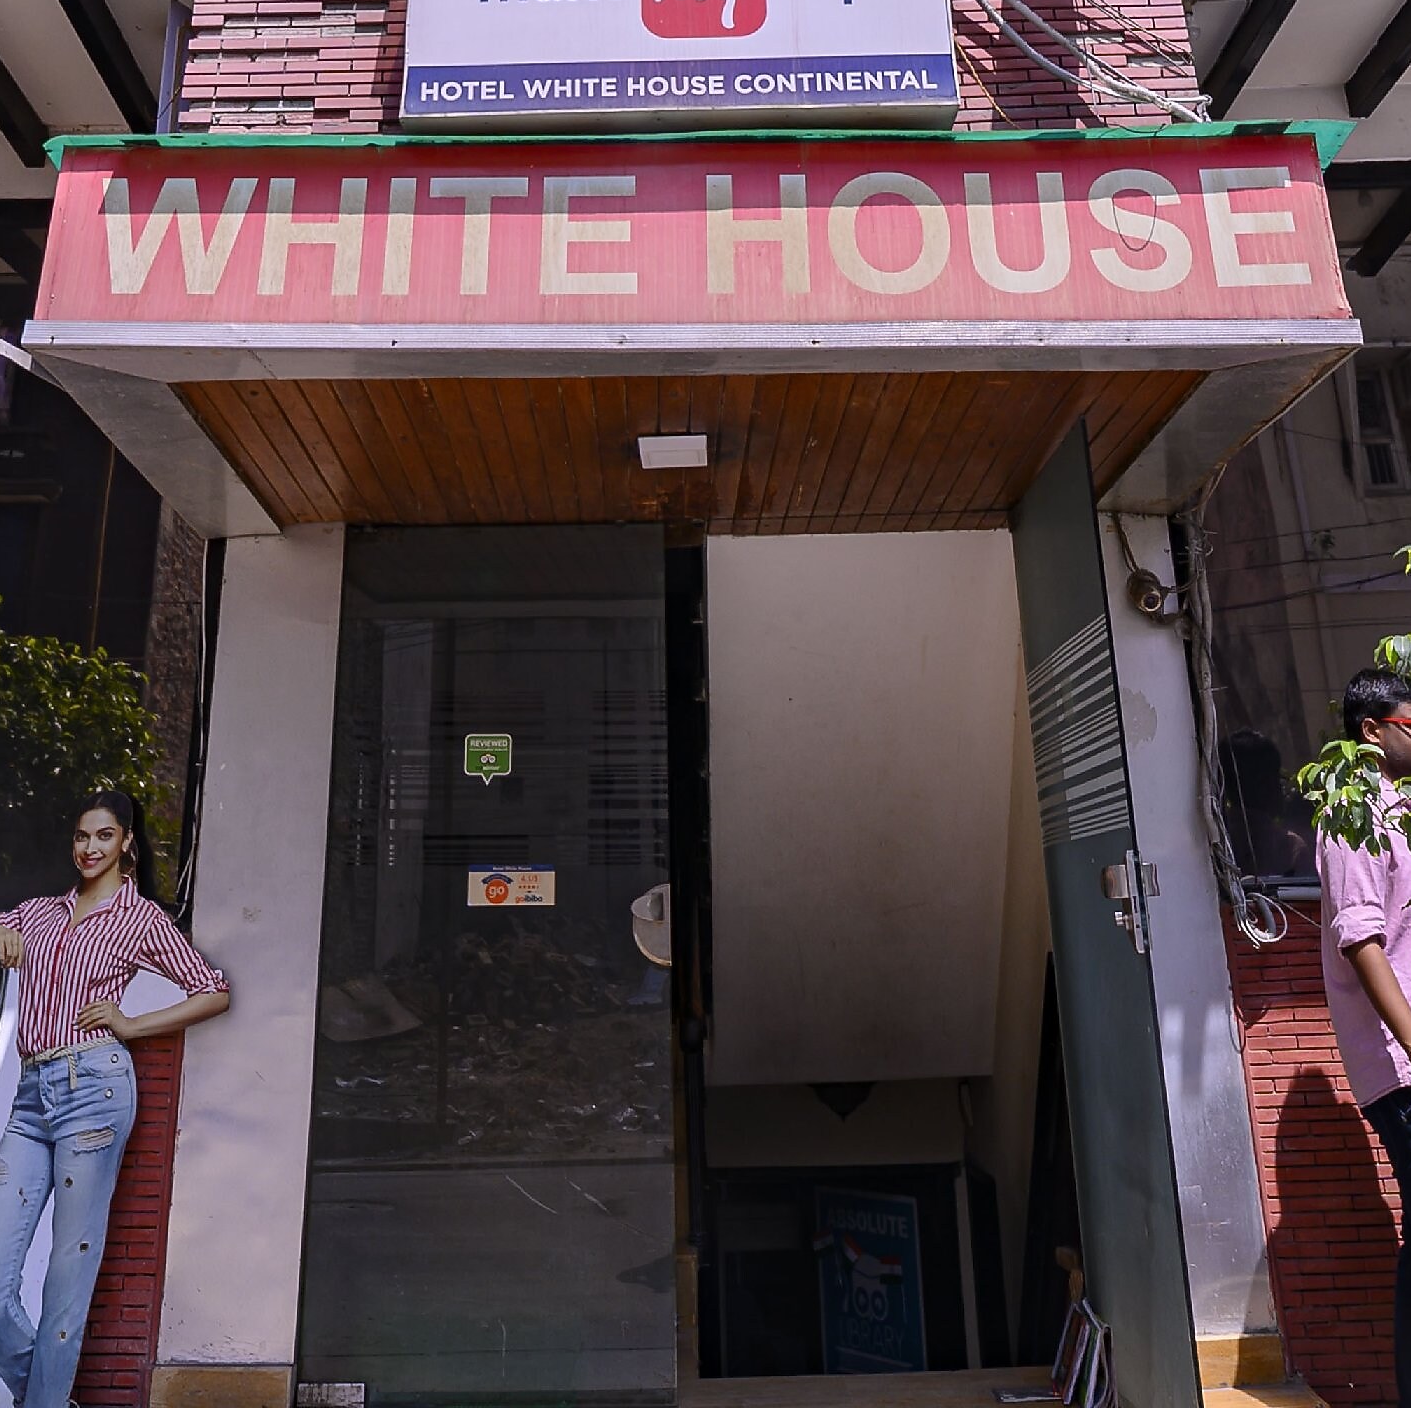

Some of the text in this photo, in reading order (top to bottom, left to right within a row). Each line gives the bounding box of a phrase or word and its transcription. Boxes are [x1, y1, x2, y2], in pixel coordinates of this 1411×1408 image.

[419, 68, 938, 103] HOTEL WHITE HOUSE CONTINENTAL
[102, 165, 1312, 296] WHITE HOUSE
[828, 1208, 909, 1239] ABSOLUTE
